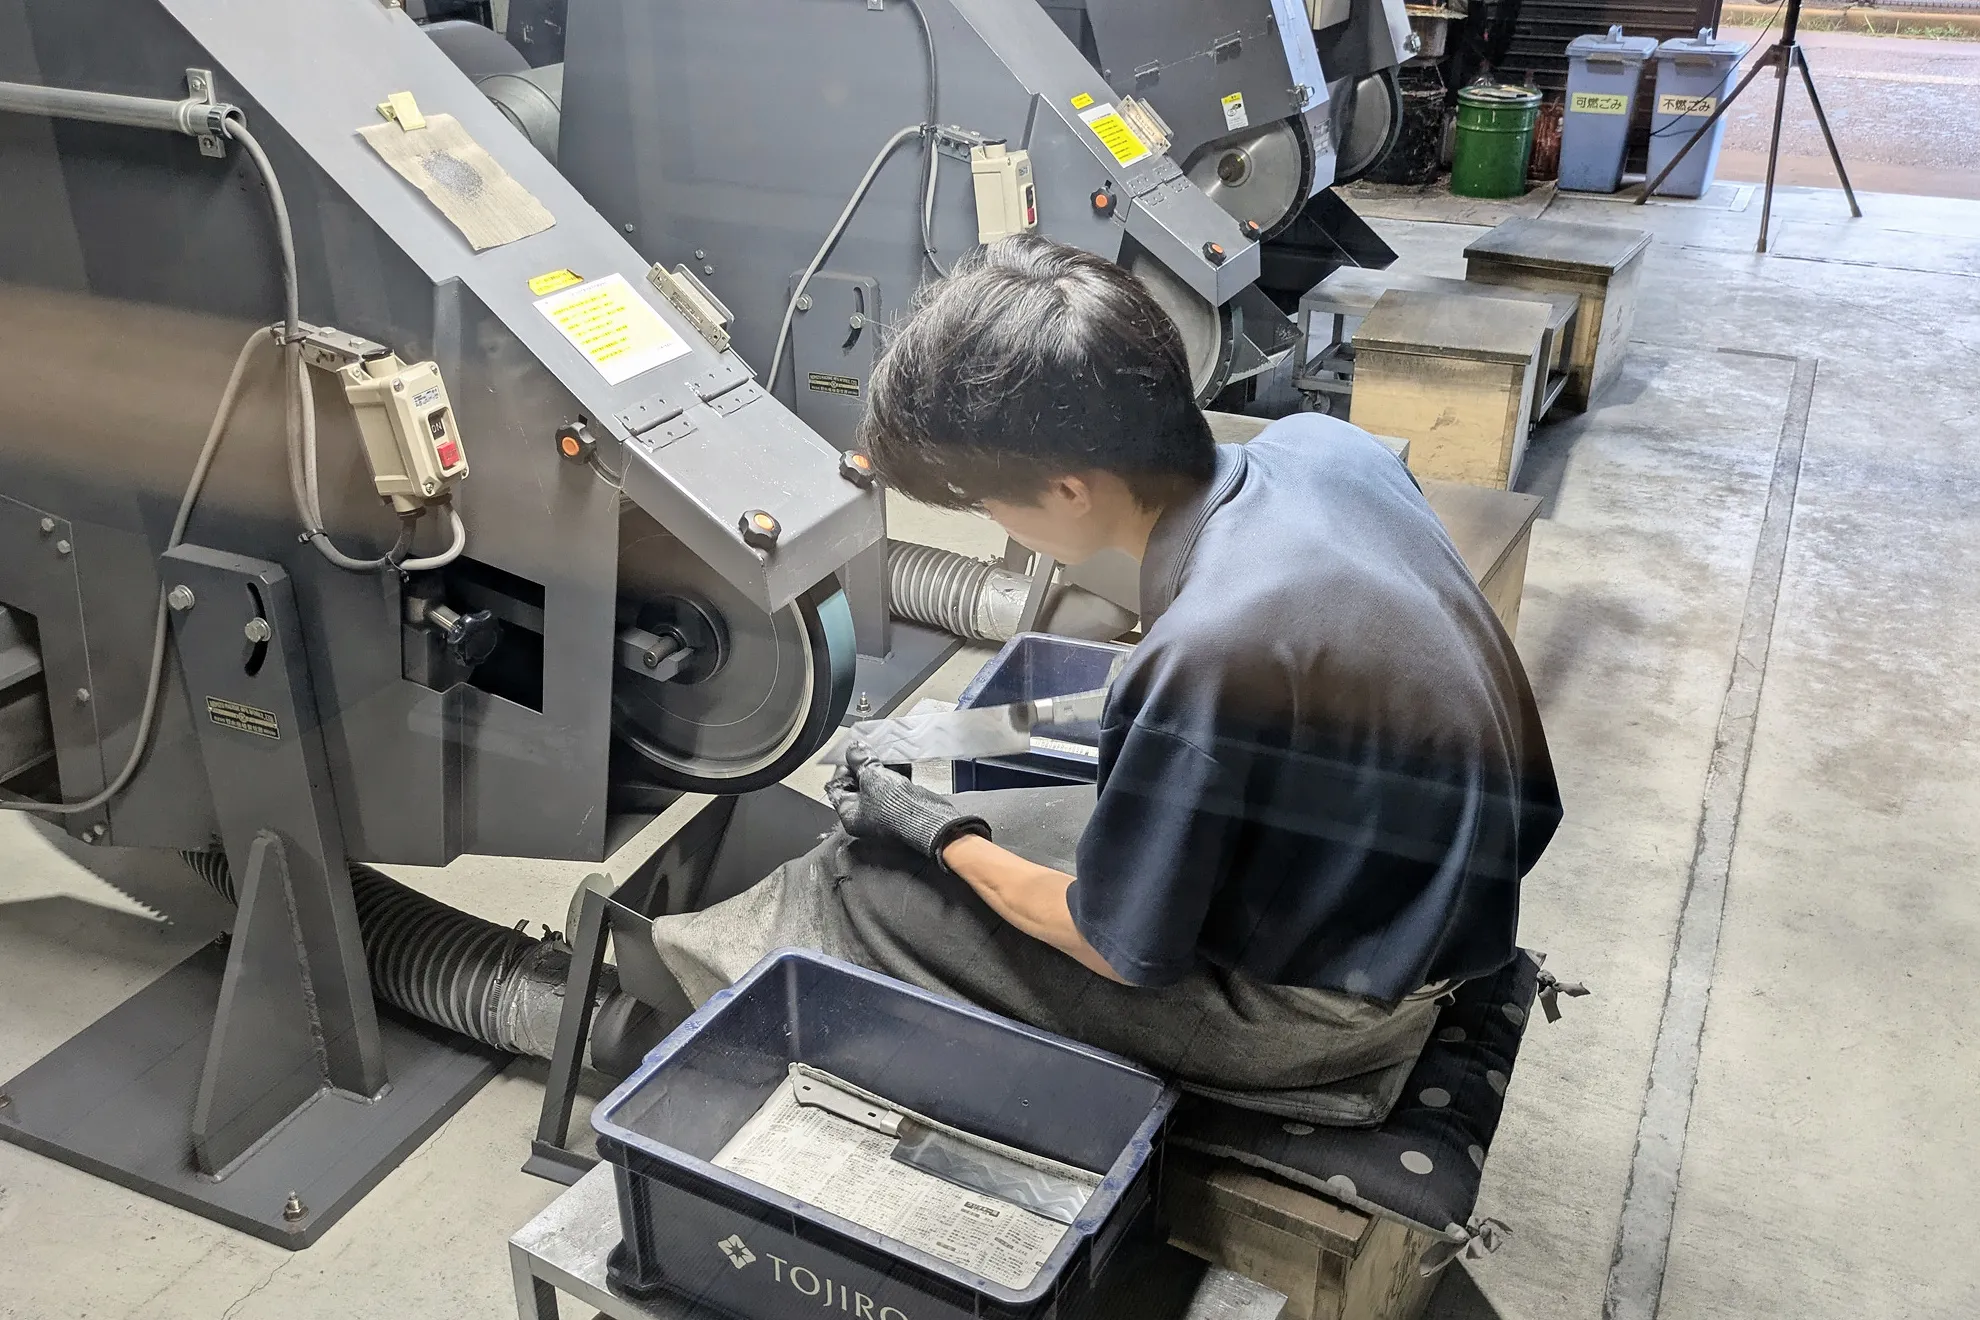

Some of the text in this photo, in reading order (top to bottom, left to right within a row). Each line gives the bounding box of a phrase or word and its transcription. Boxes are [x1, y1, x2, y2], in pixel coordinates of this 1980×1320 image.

[1576, 96, 1622, 110] 可燃ごみ
[1663, 98, 1711, 112] 不燃ごみ
[431, 421, 443, 433] ON
